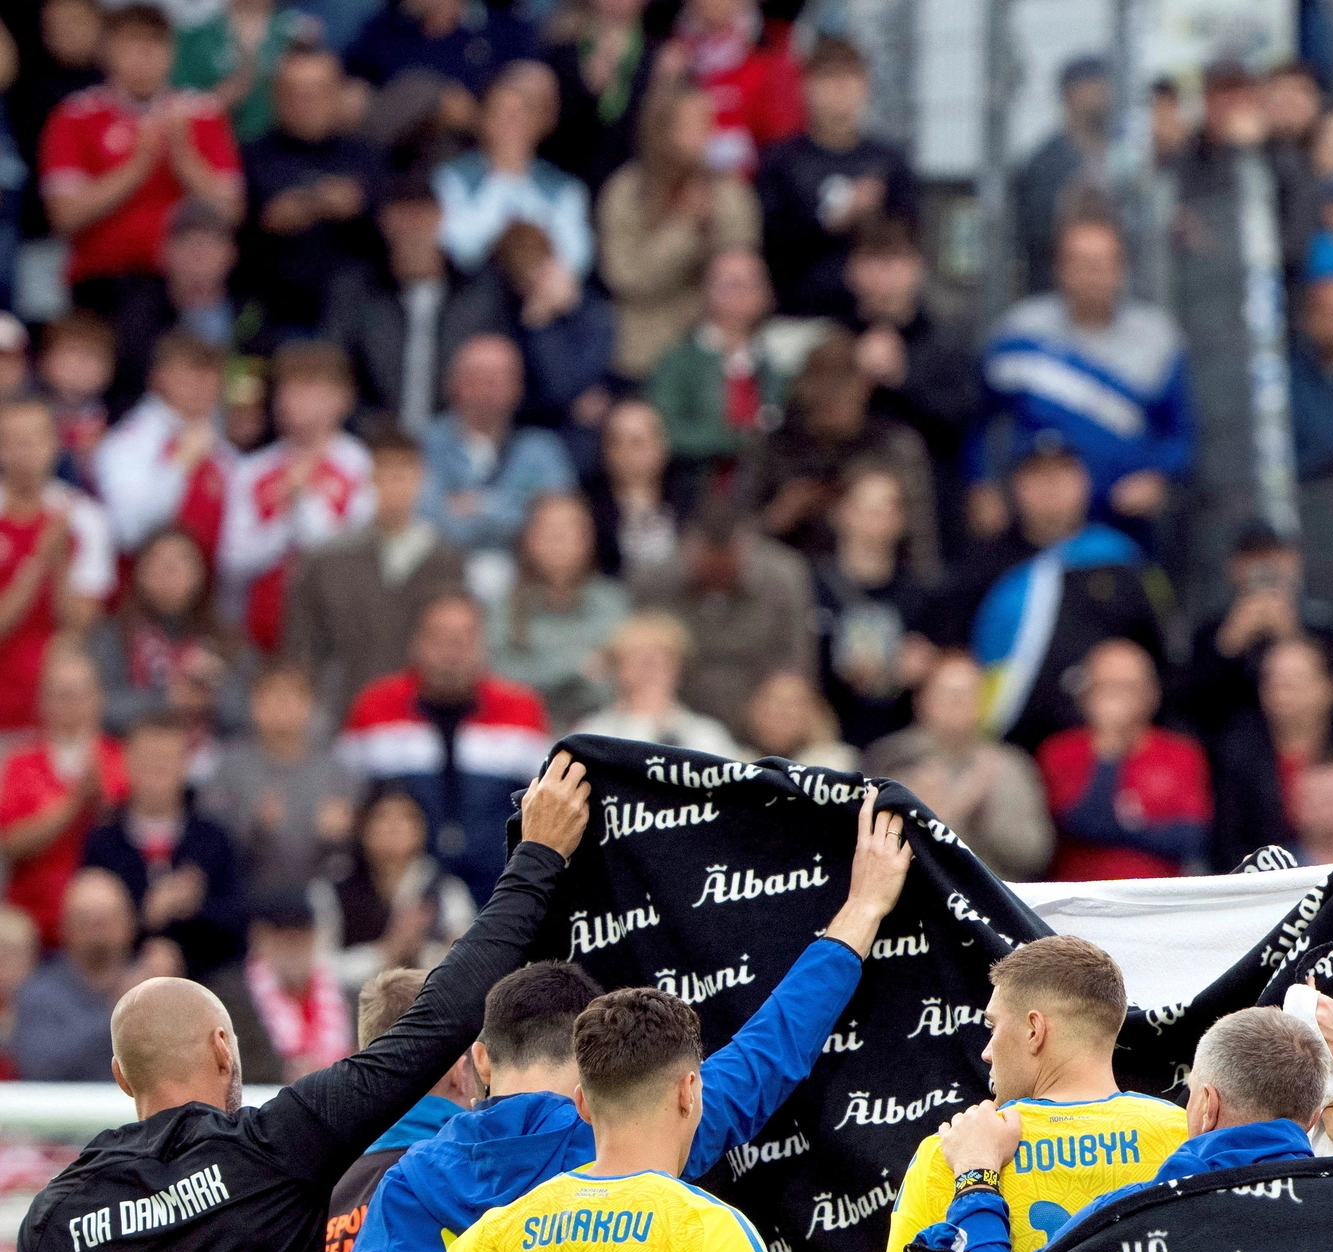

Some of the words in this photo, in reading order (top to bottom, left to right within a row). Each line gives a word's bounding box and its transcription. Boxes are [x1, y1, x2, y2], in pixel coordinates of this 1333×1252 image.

[599, 795, 720, 846] Albani
[692, 853, 829, 907] Albani
[834, 1082, 964, 1130] Albani
[1014, 1129, 1140, 1174] DOVBYK
[69, 1207, 112, 1252] FOR
[119, 1164, 230, 1235] DANMARK
[326, 1205, 368, 1243] SPO
[523, 1209, 653, 1250] SUDAKOV
